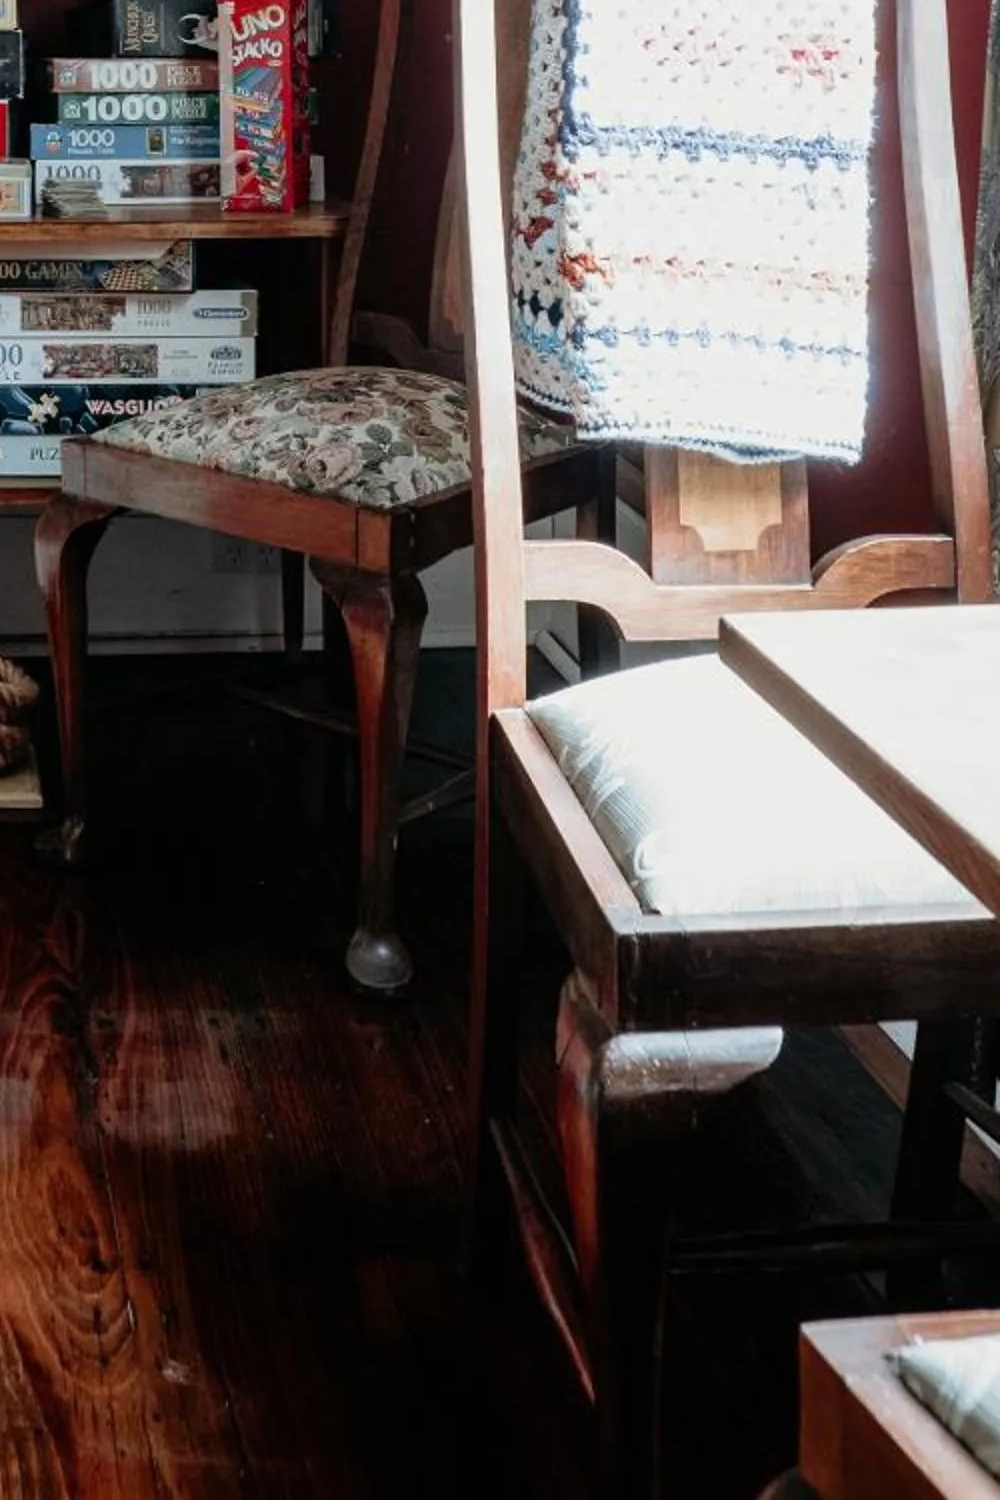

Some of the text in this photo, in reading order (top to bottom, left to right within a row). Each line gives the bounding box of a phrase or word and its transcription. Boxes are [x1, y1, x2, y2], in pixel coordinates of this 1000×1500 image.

[231, 4, 285, 42] UNO
[231, 37, 282, 67] STACKO
[89, 62, 157, 89] 1000
[82, 94, 168, 121] 1000
[67, 129, 115, 147] 1000
[30, 446, 61, 462] PUZ
